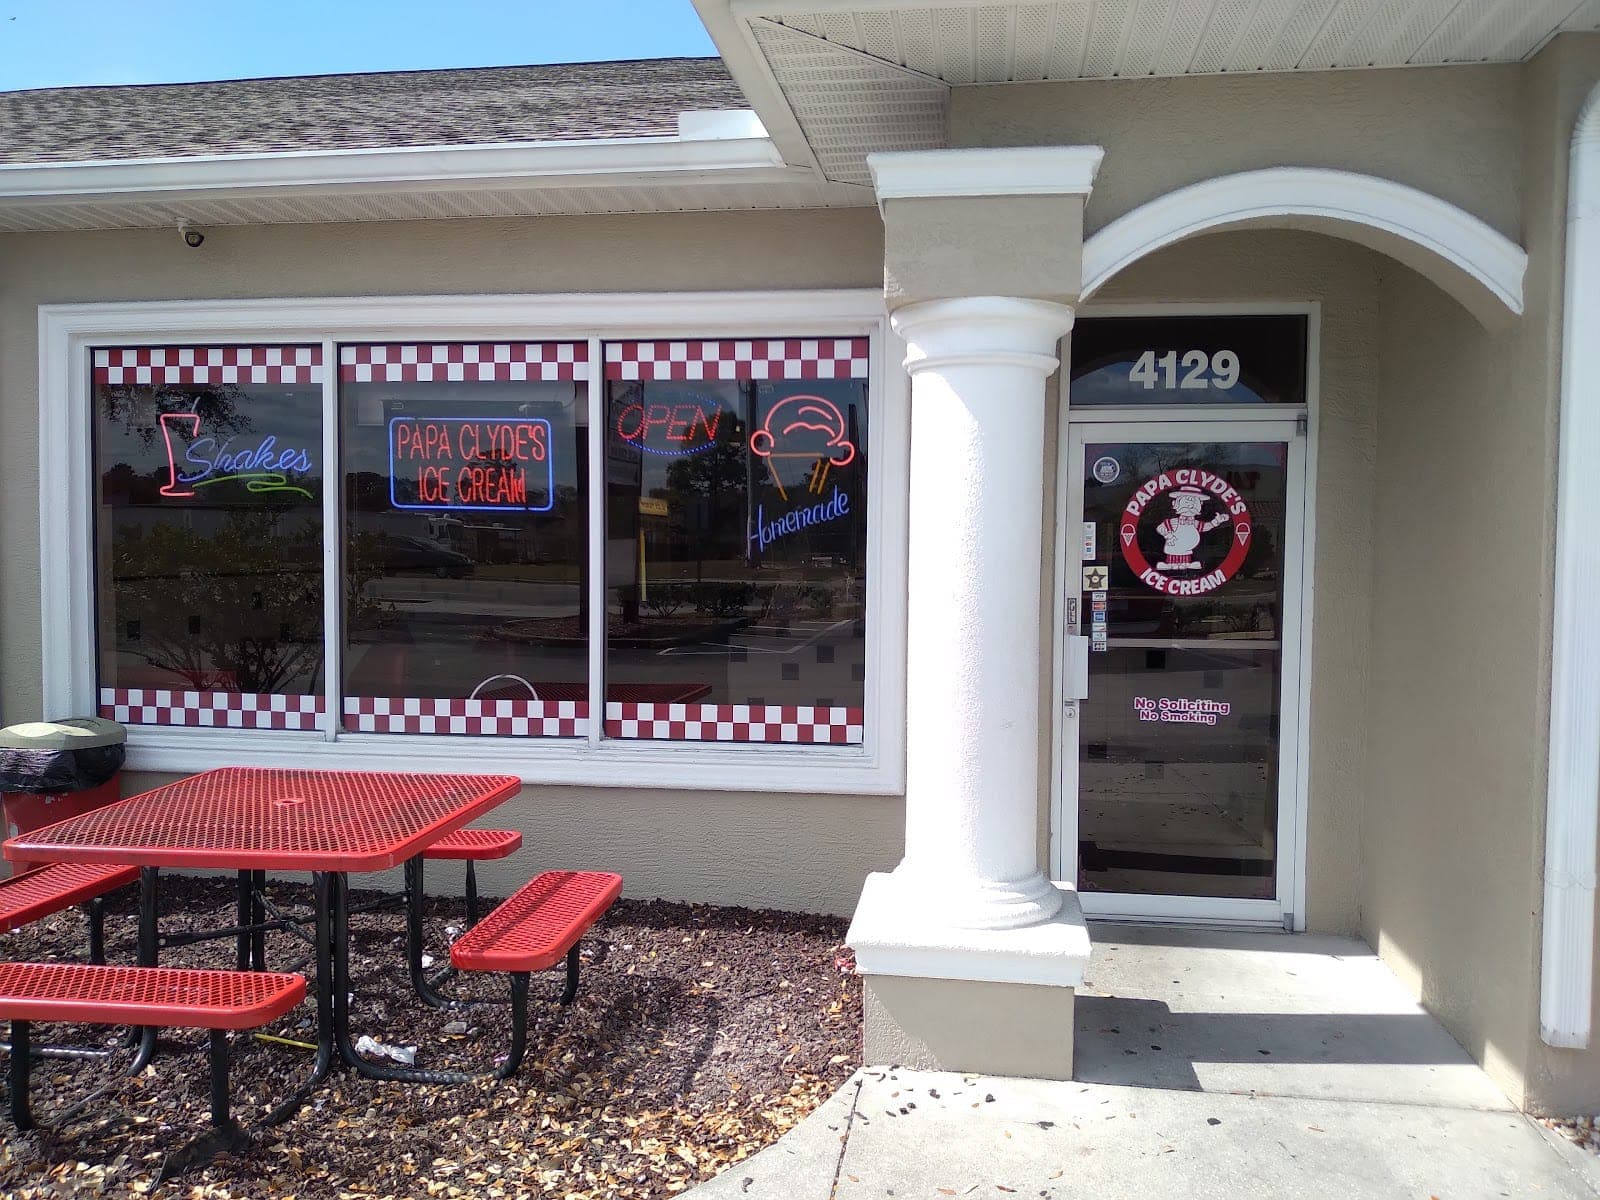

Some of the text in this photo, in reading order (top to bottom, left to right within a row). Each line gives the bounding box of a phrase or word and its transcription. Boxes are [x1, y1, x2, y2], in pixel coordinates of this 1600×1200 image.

[1129, 349, 1240, 389] 4129
[616, 402, 722, 441] OPEN
[177, 435, 312, 482] Shakes
[397, 424, 546, 461] PAPA CLYDE'S
[418, 466, 527, 503] ICE CREAM
[1126, 469, 1247, 516] PAPA CLYDE'S
[748, 485, 850, 552] Homemade
[1139, 568, 1227, 595] ICE CREAM
[1134, 697, 1230, 715] No Soliciting
[1140, 710, 1216, 725] No Smoking
